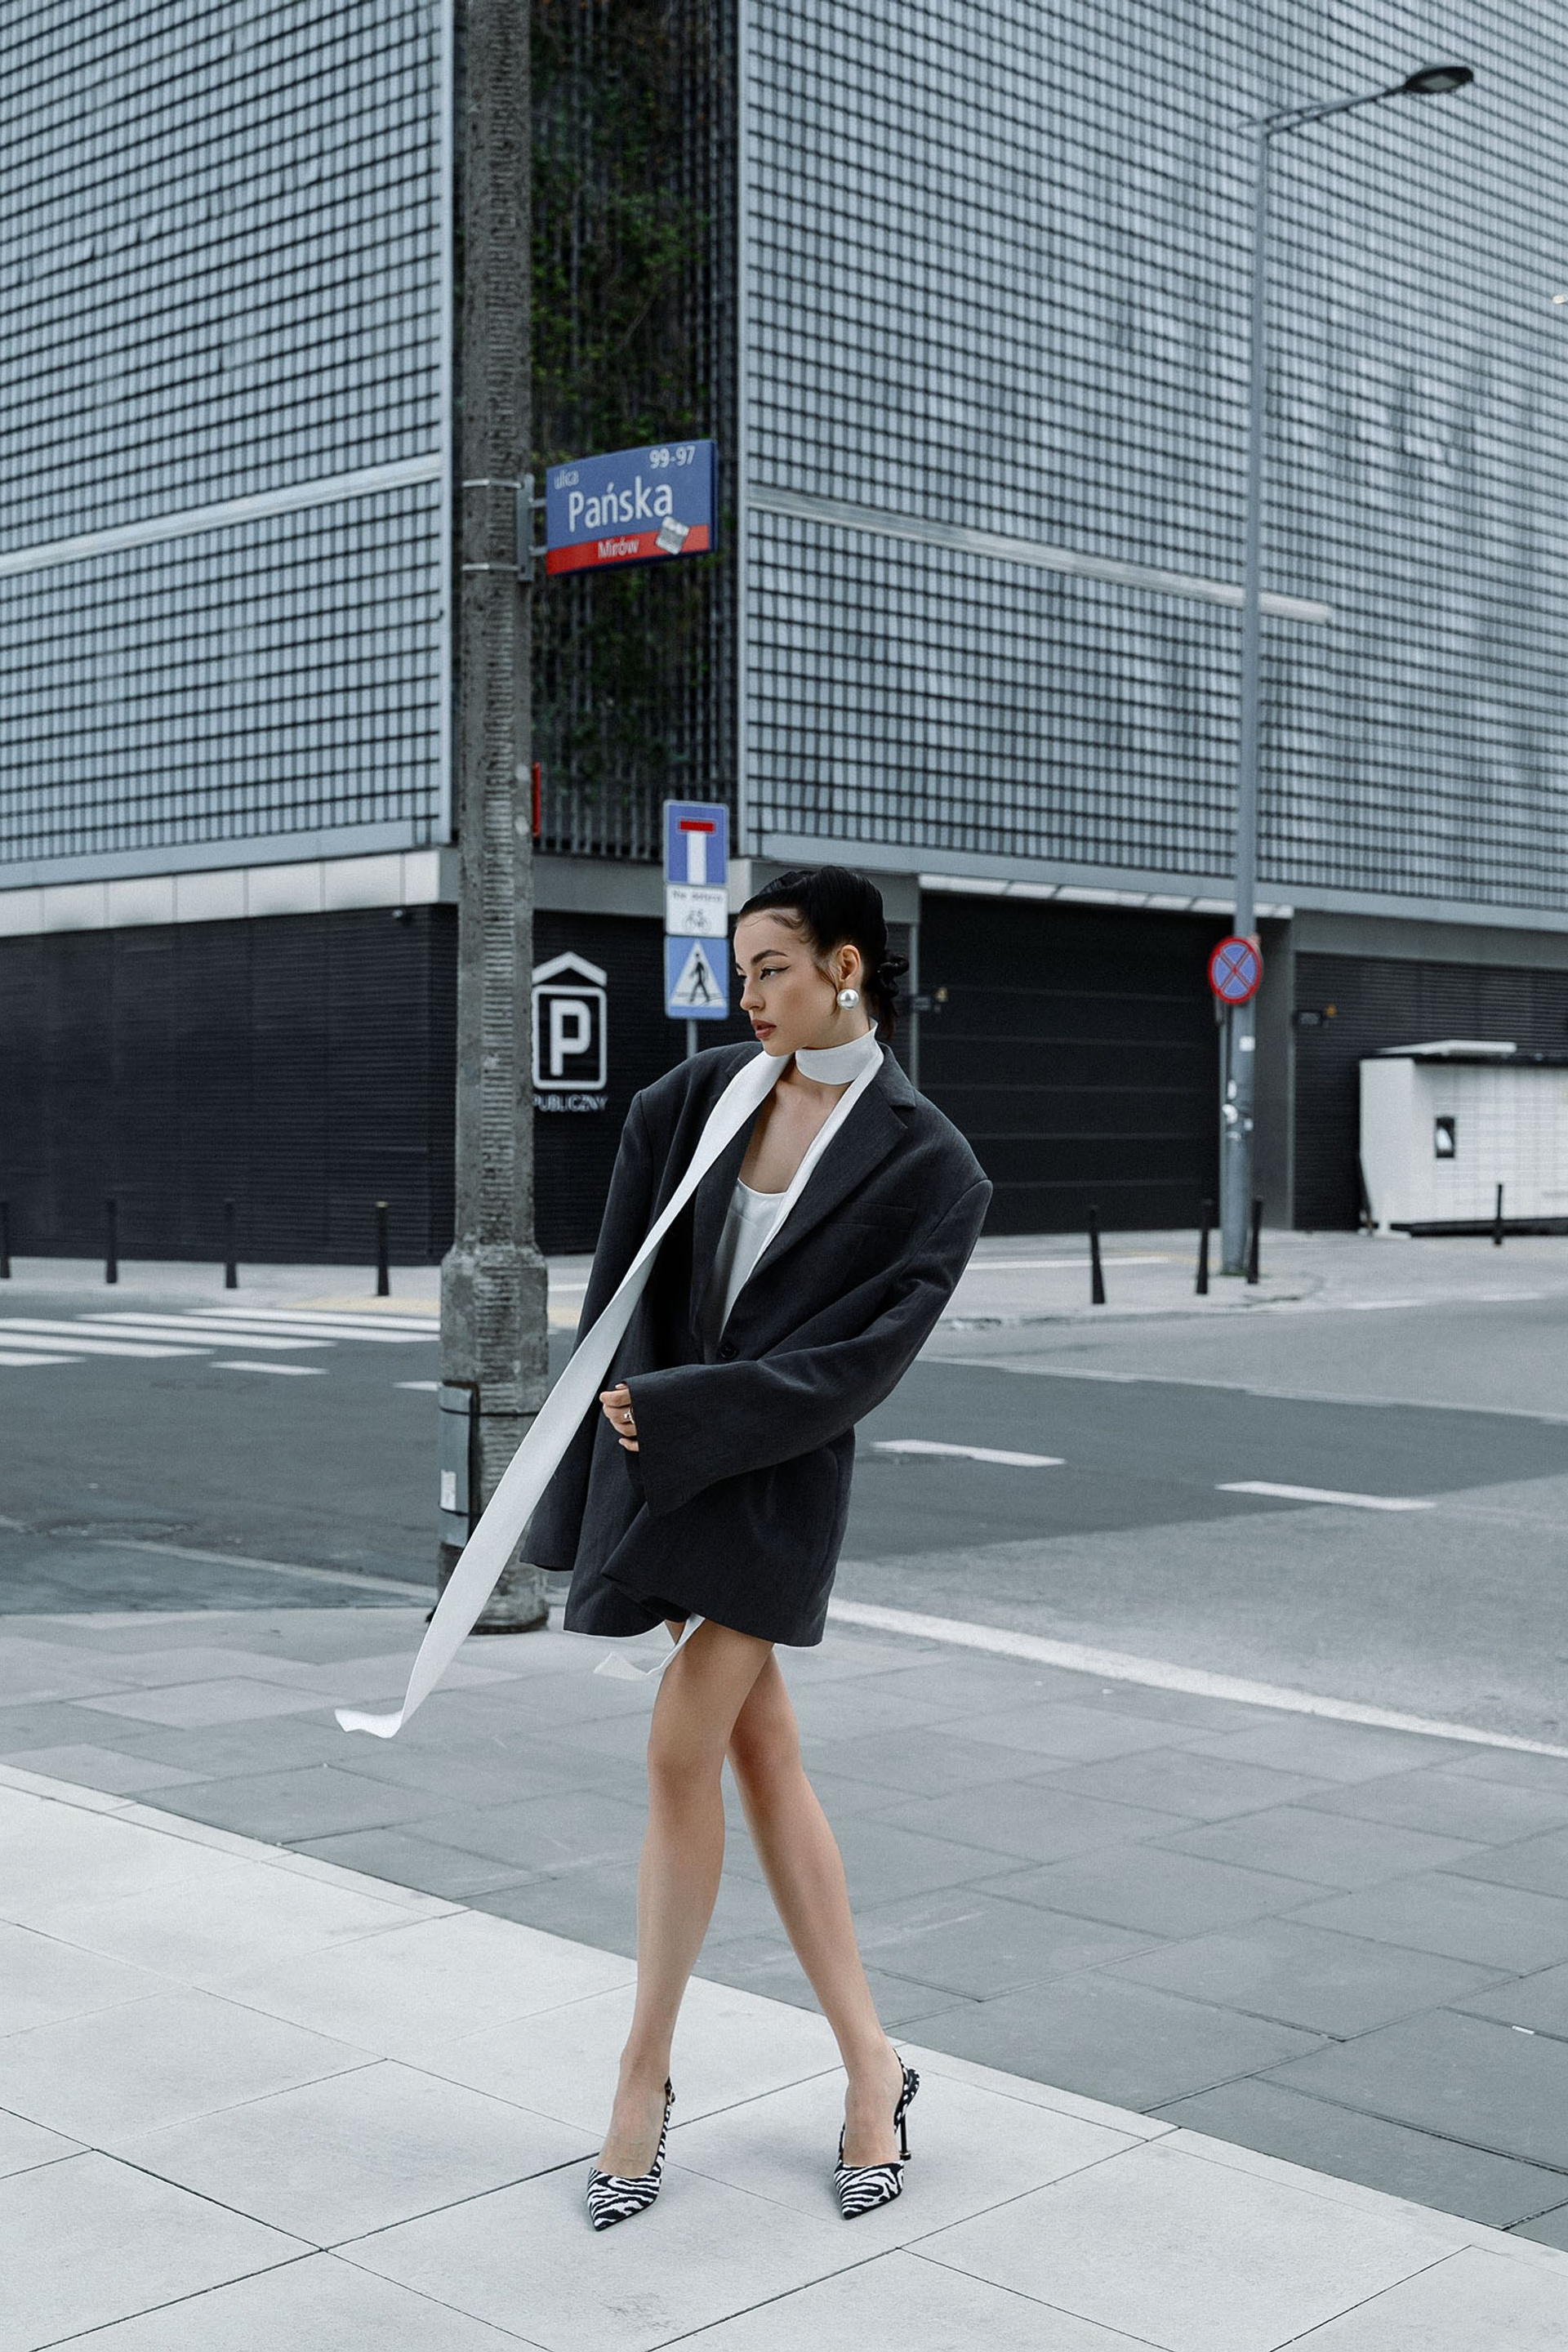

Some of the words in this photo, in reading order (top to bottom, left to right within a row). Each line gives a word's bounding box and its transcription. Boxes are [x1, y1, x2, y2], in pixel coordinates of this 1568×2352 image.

[649, 445, 695, 469] 99-97
[555, 470, 580, 489] ulica
[569, 475, 673, 532] Pańska
[598, 537, 639, 559] Mirów
[550, 999, 591, 1076] P
